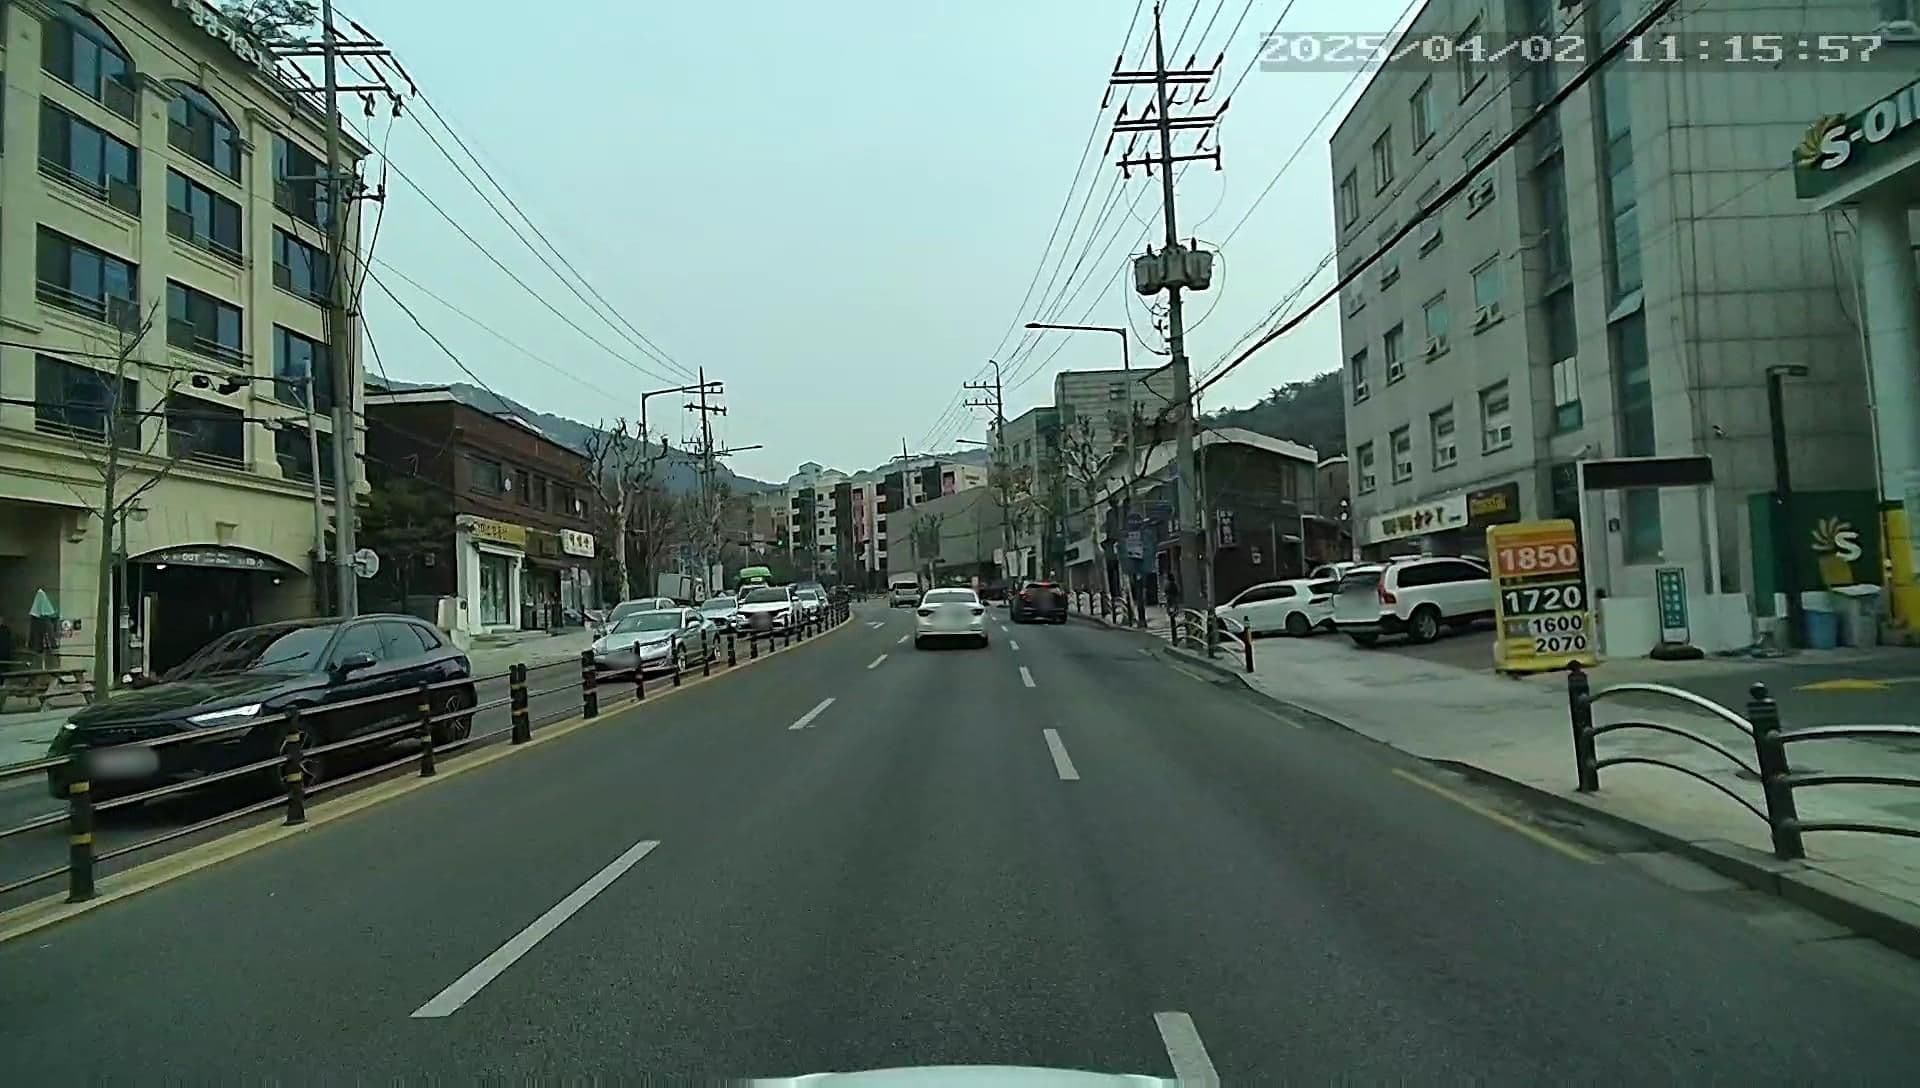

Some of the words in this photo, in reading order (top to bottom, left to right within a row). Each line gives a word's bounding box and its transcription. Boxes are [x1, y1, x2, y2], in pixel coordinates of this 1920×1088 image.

[1500, 543, 1577, 571] 1850
[1505, 586, 1582, 613] 1720
[1533, 615, 1582, 634] 1600
[1536, 635, 1586, 652] 2070
